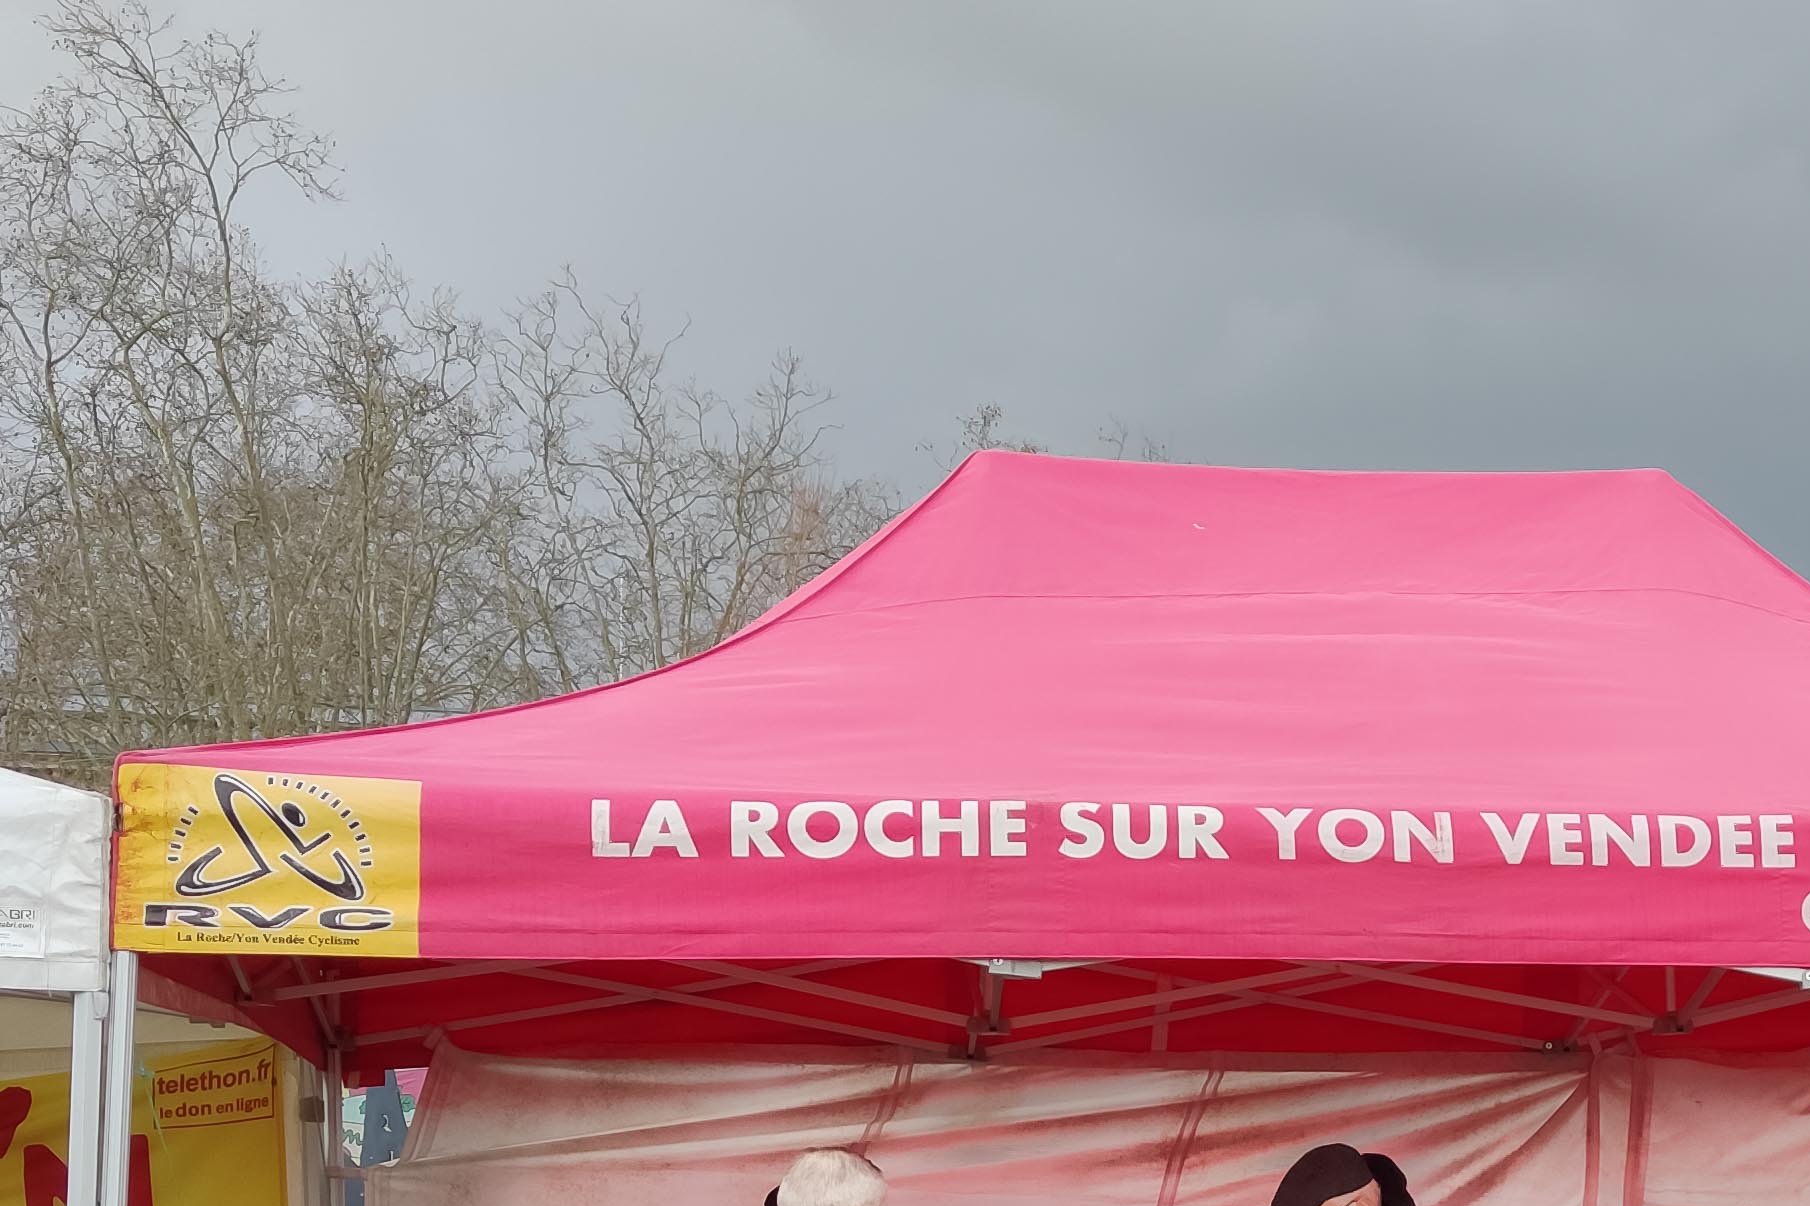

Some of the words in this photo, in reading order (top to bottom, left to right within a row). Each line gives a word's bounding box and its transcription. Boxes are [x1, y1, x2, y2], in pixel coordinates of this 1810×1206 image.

[591, 800, 699, 859] LA
[730, 799, 1028, 860] ROCHE
[1058, 801, 1230, 861] SUR
[1256, 807, 1455, 864] YON
[1479, 811, 1796, 868] VENDEE
[144, 903, 394, 931] RVC
[177, 931, 192, 942] La
[263, 932, 305, 945] Vendée
[308, 935, 360, 948] Cyclisme
[156, 1058, 272, 1096] telethon.fr
[159, 1106, 173, 1120] le
[175, 1101, 212, 1119] don
[215, 1102, 234, 1115] en
[235, 1095, 270, 1114] ligne
